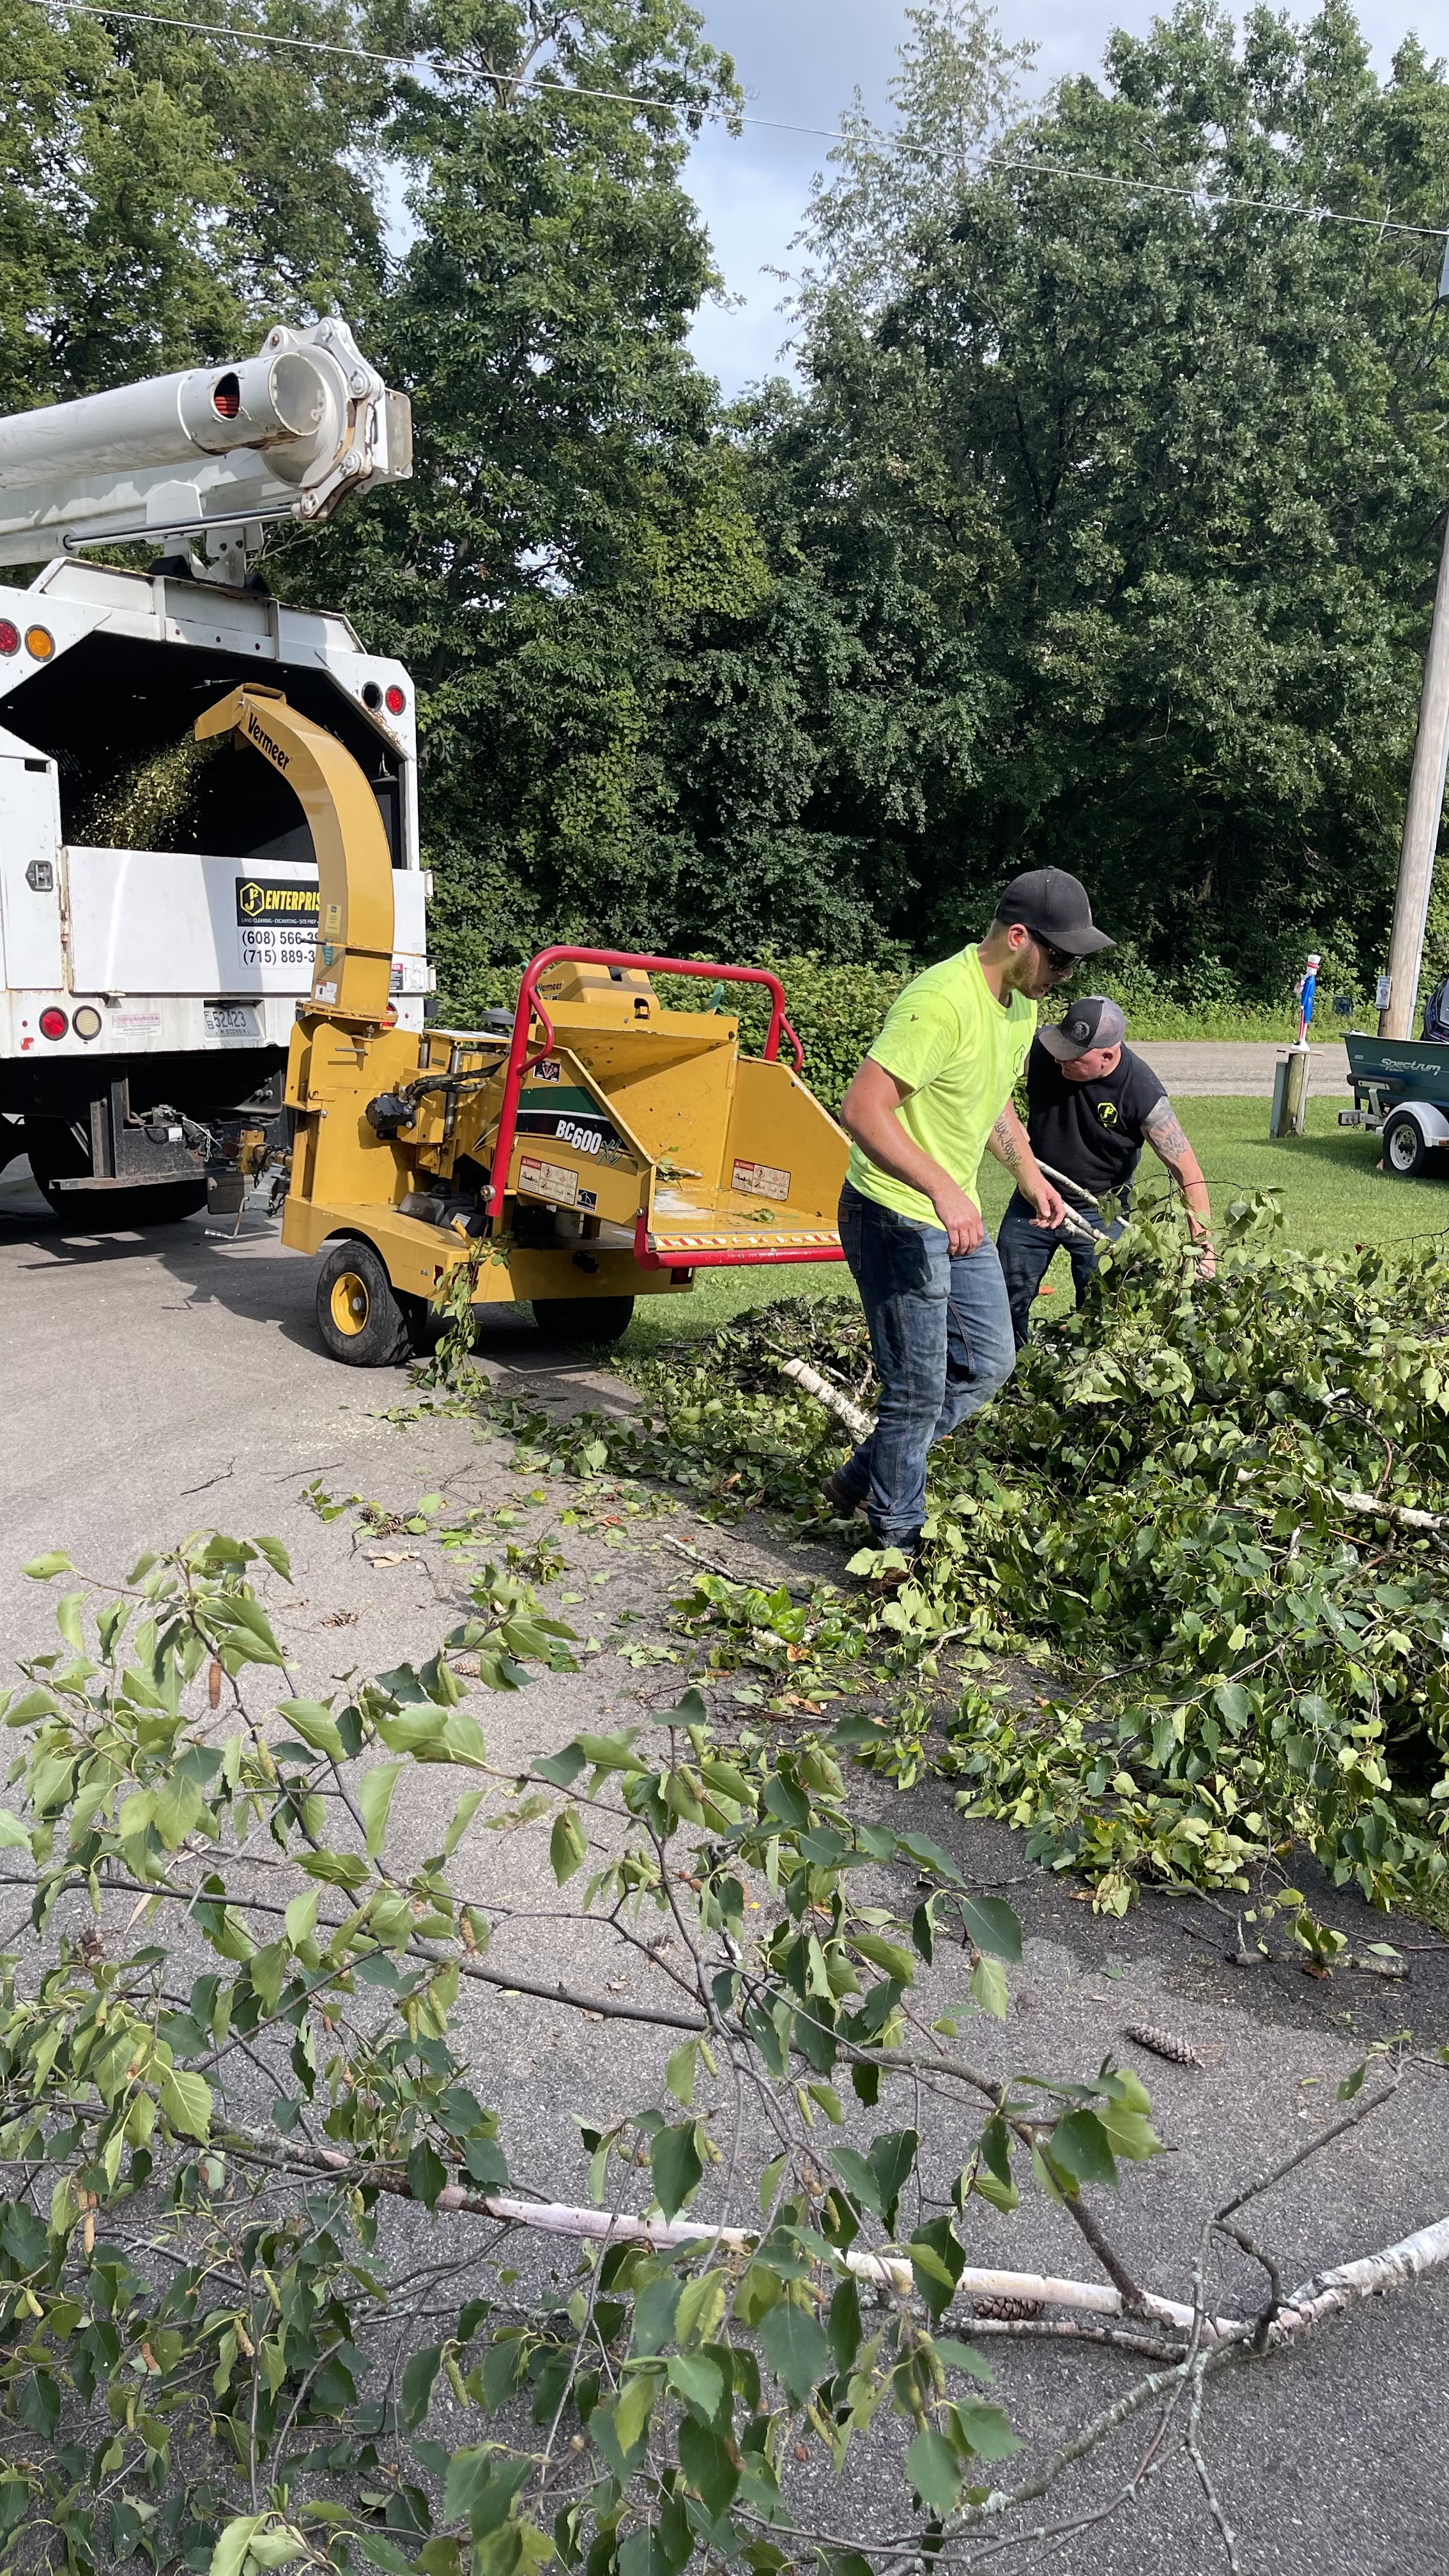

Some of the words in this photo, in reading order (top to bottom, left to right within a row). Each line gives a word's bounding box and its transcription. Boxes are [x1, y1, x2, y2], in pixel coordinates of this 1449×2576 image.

[248, 712, 289, 770] Vermeer
[242, 930, 275, 947] (608)
[243, 949, 277, 965] (715)
[212, 1010, 246, 1027] 52423
[1379, 1058, 1441, 1076] Spectrum
